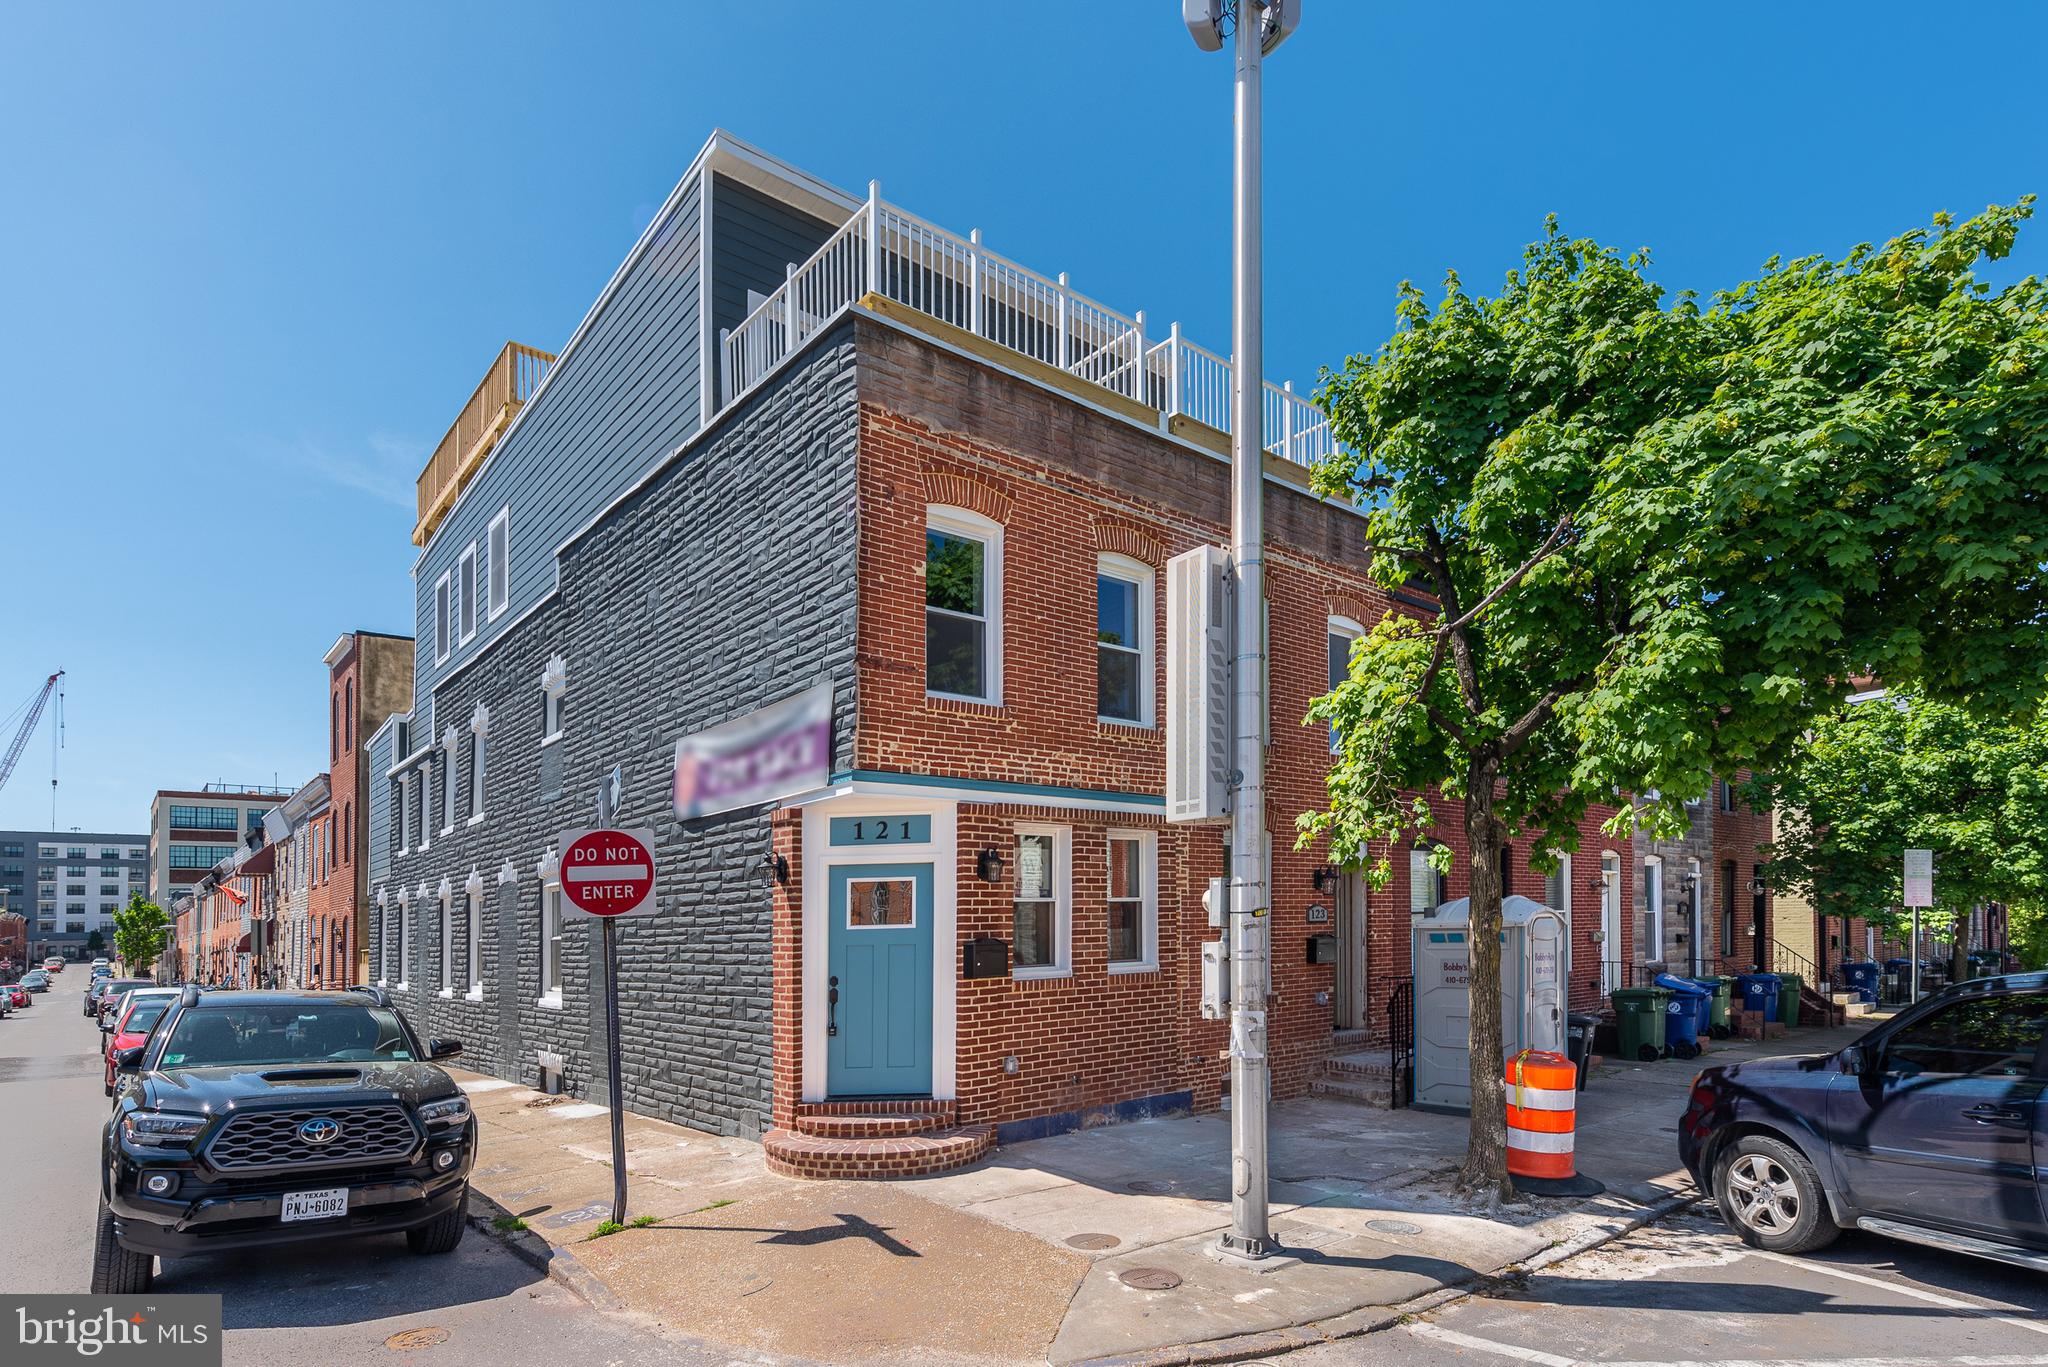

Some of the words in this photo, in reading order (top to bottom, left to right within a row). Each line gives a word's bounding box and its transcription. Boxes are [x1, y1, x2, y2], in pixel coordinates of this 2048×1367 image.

[854, 821, 911, 840] 121
[574, 848, 597, 861] DO
[606, 847, 639, 861] NOT
[582, 885, 634, 899] ENTER
[1311, 909, 1325, 919] 123
[304, 1191, 329, 1199] TEXAS
